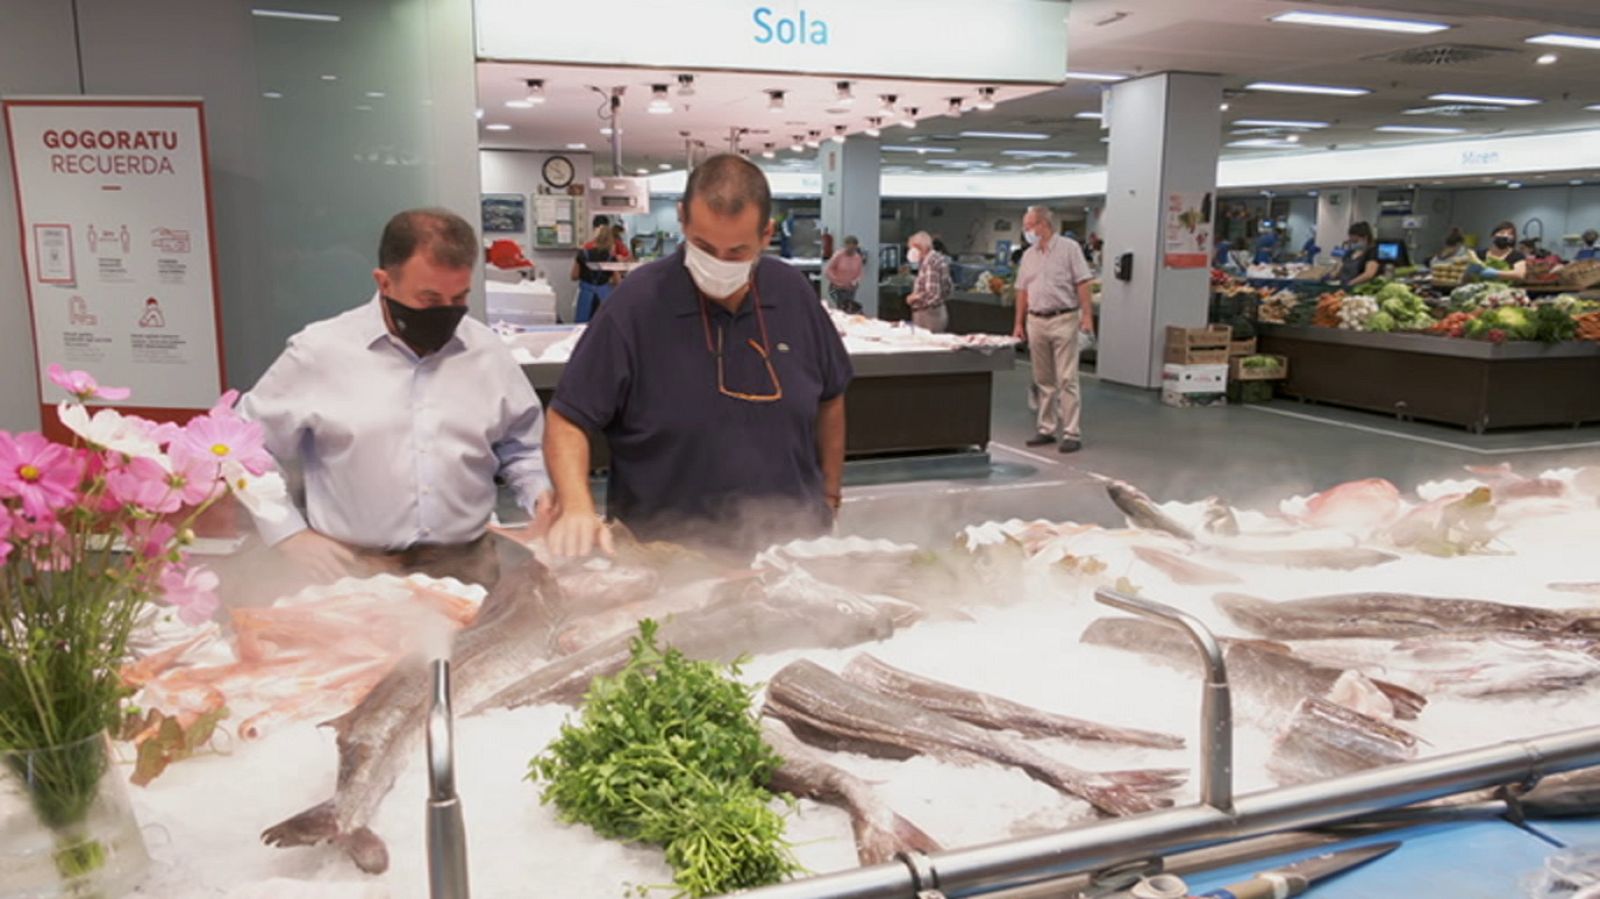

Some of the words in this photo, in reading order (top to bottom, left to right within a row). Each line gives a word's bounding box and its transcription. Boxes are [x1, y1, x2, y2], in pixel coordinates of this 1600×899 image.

[752, 7, 829, 46] Sola
[43, 130, 178, 149] GOGORATU
[51, 154, 175, 175] RECUERDA
